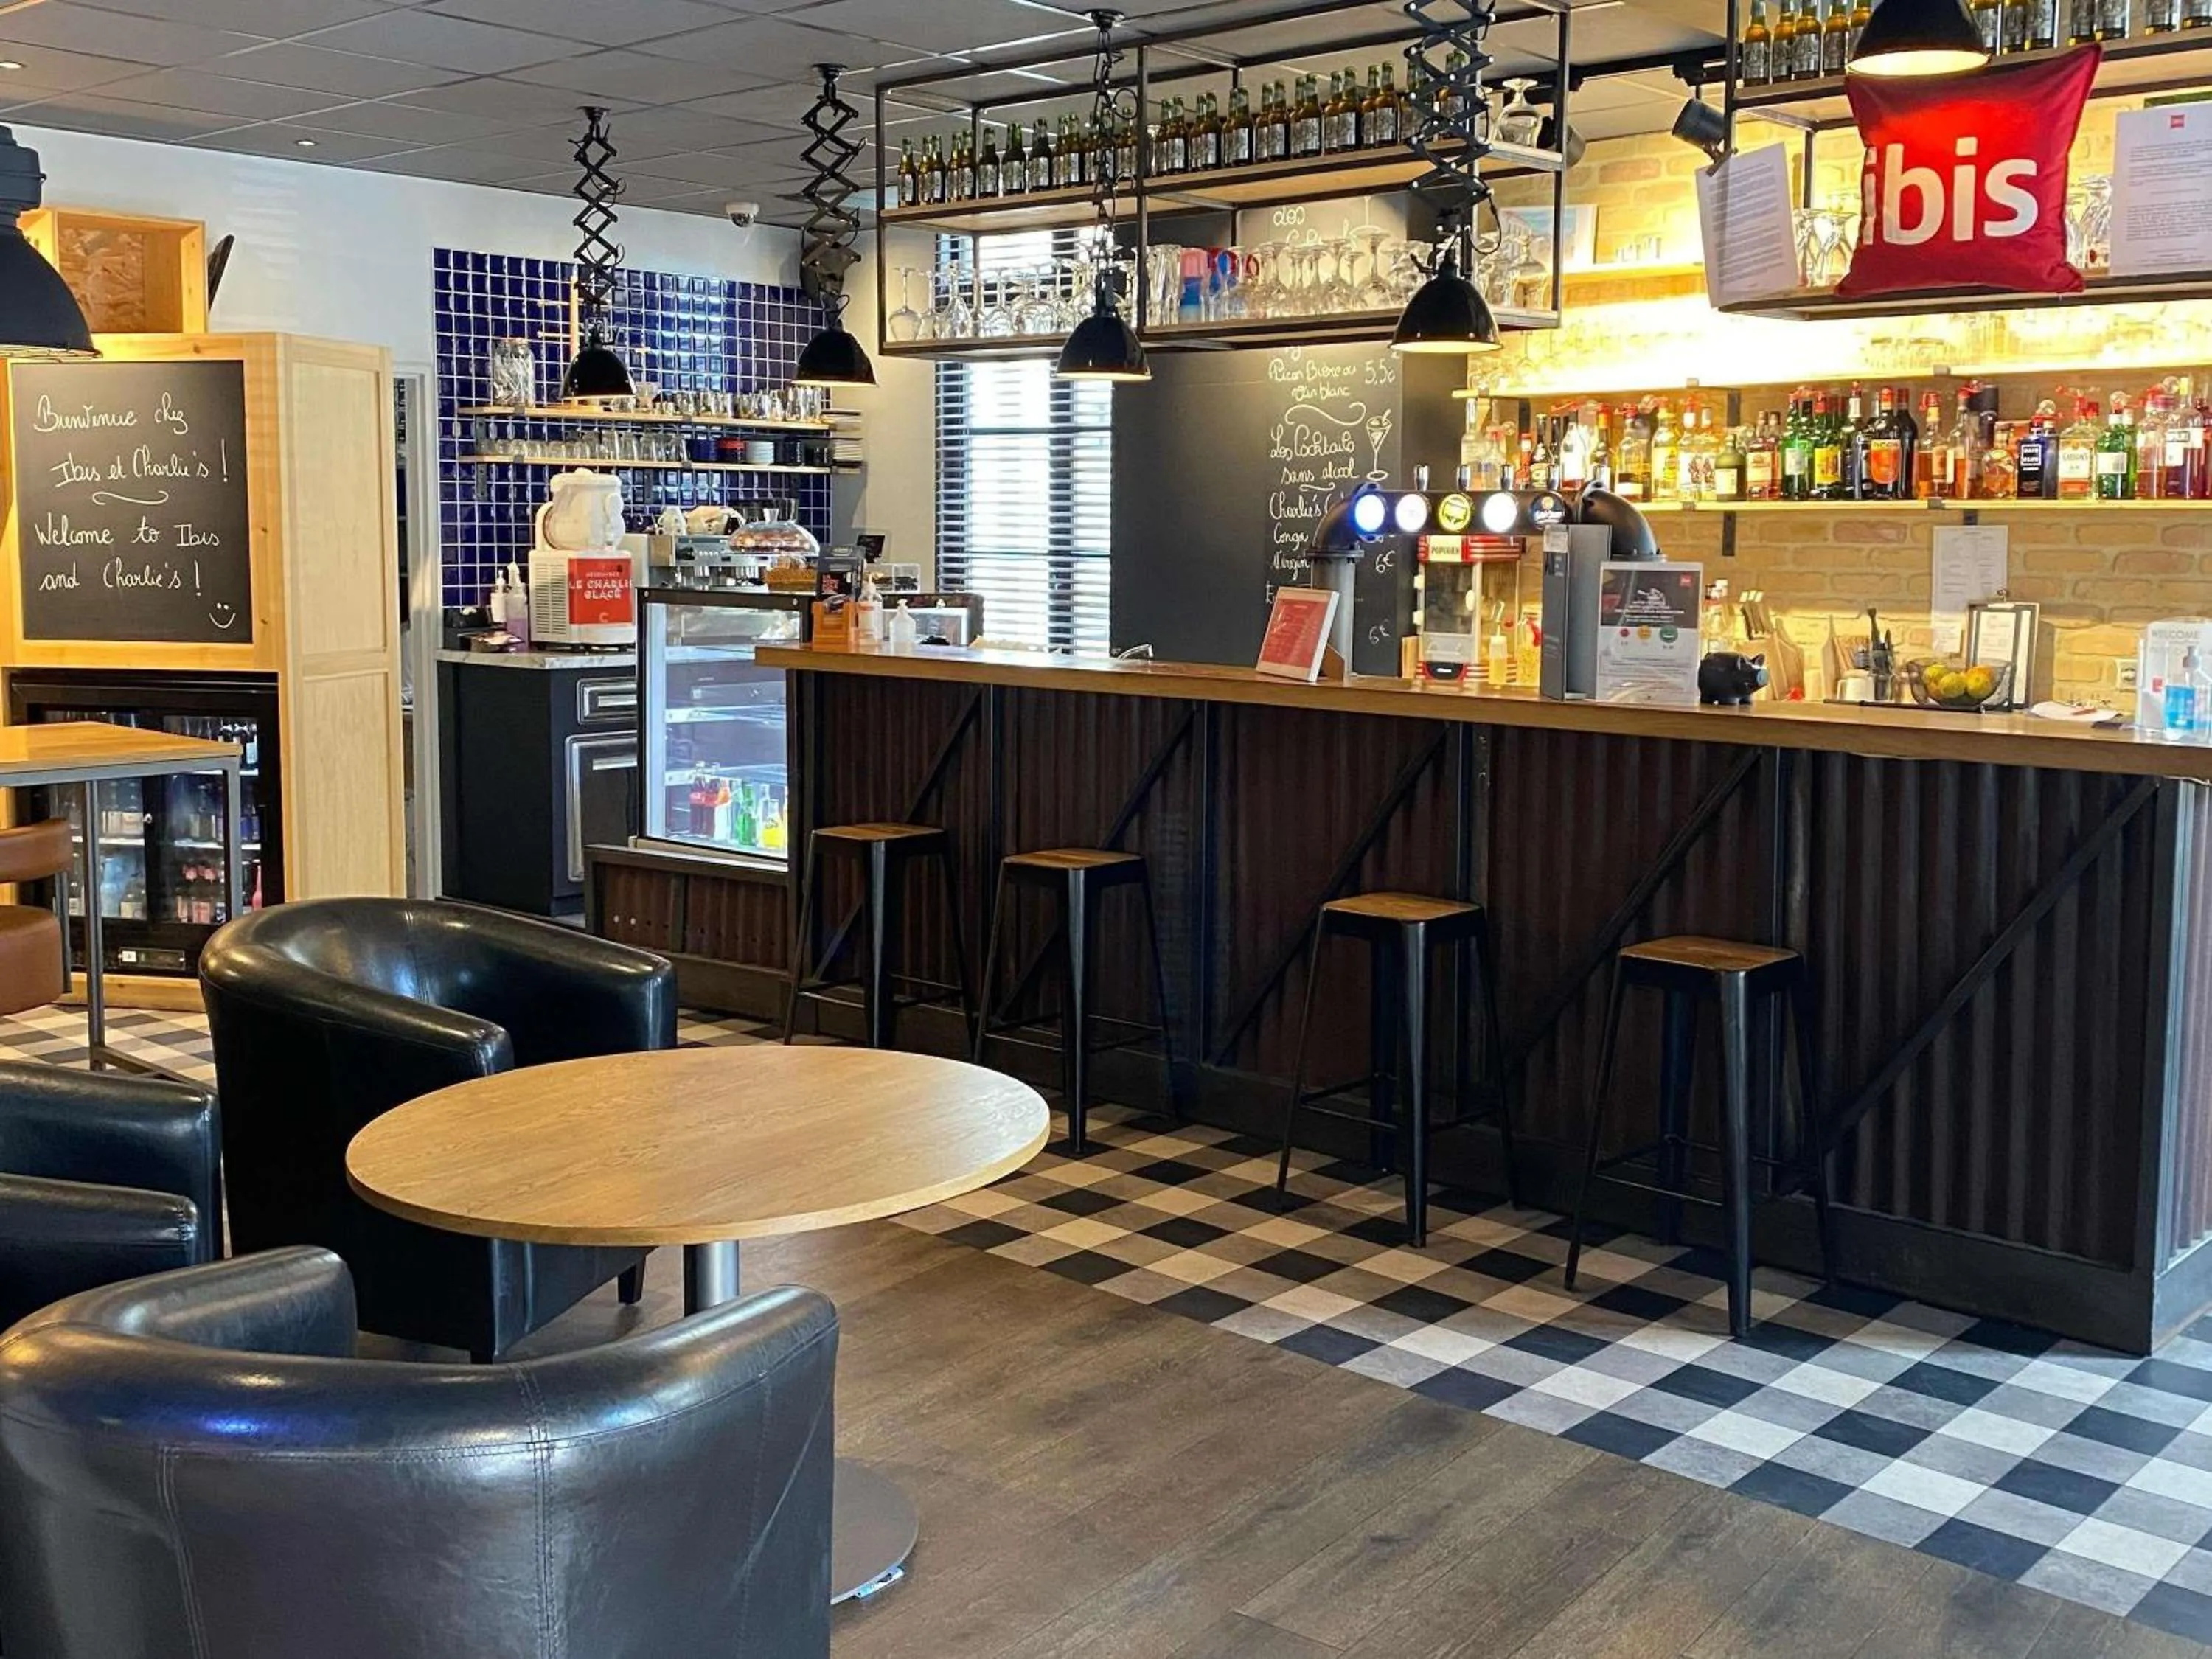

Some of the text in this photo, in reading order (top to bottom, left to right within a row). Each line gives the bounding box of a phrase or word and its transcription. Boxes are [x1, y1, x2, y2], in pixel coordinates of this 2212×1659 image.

[1862, 136, 2039, 245] ibis
[154, 392, 189, 434] chez
[50, 452, 101, 487] Ibis
[107, 455, 127, 480] et
[133, 445, 209, 479] Charlie's
[1281, 457, 1360, 484] sans alcool
[1269, 491, 1322, 519] Charlie's
[35, 512, 220, 547] Welcome to Ibis
[40, 562, 80, 591] and
[103, 557, 181, 589] Charlie's
